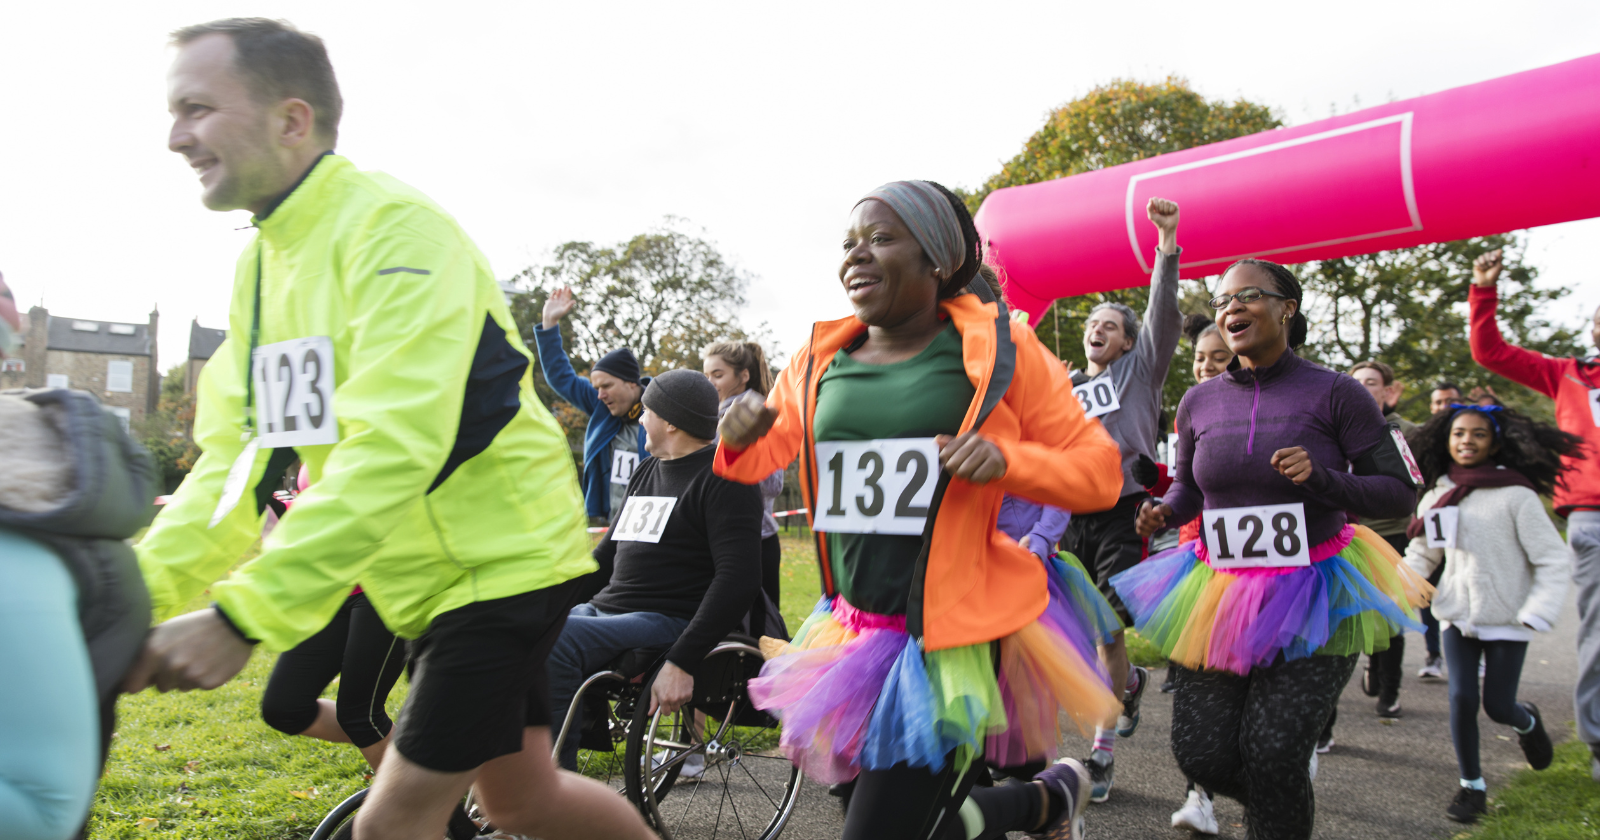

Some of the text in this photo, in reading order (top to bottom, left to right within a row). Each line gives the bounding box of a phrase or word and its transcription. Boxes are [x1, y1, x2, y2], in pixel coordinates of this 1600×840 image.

[261, 348, 325, 435] 123
[615, 454, 635, 480] 11
[825, 449, 929, 518] 132
[617, 500, 669, 536] 131
[1211, 511, 1302, 561] 128
